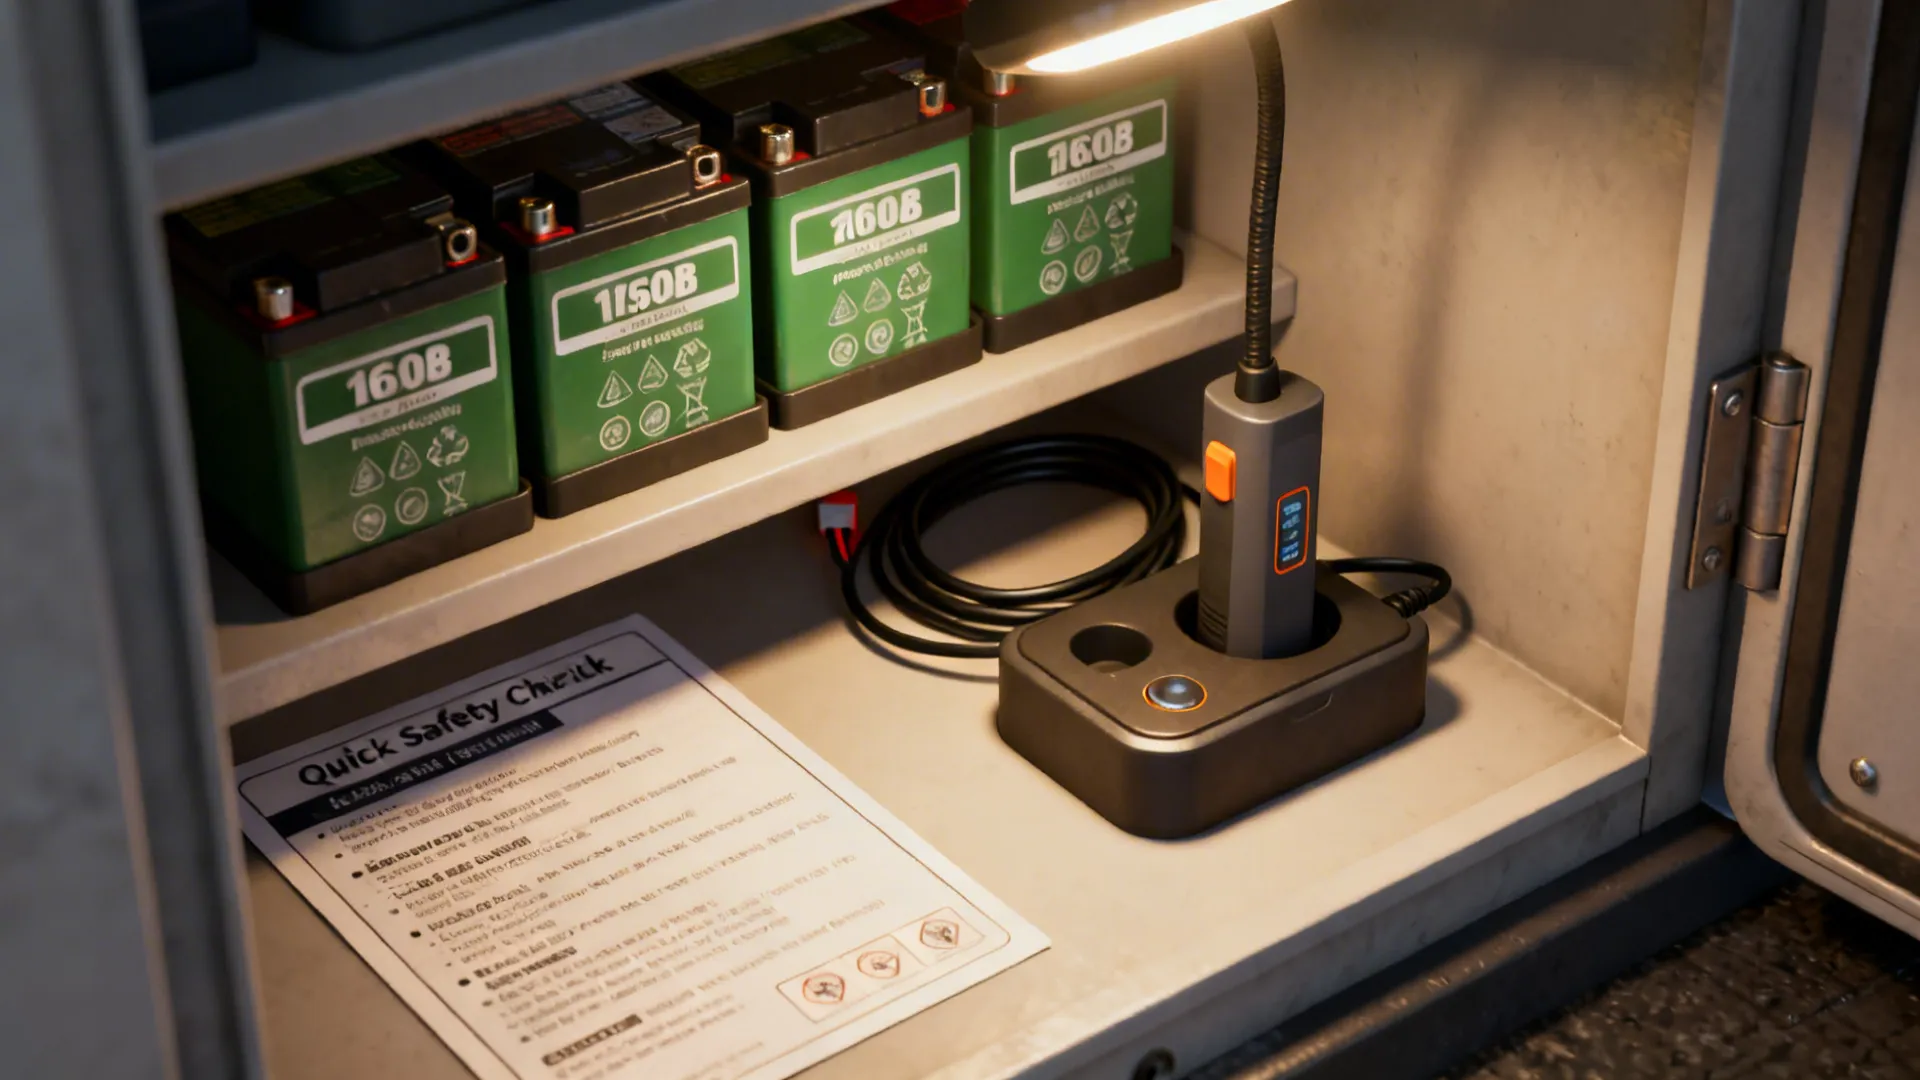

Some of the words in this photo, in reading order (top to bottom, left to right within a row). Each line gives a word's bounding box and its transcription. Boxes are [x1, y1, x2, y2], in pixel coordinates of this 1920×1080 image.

[346, 343, 452, 407] 160B
[298, 738, 398, 787] Quick
[399, 697, 499, 748] Safety
